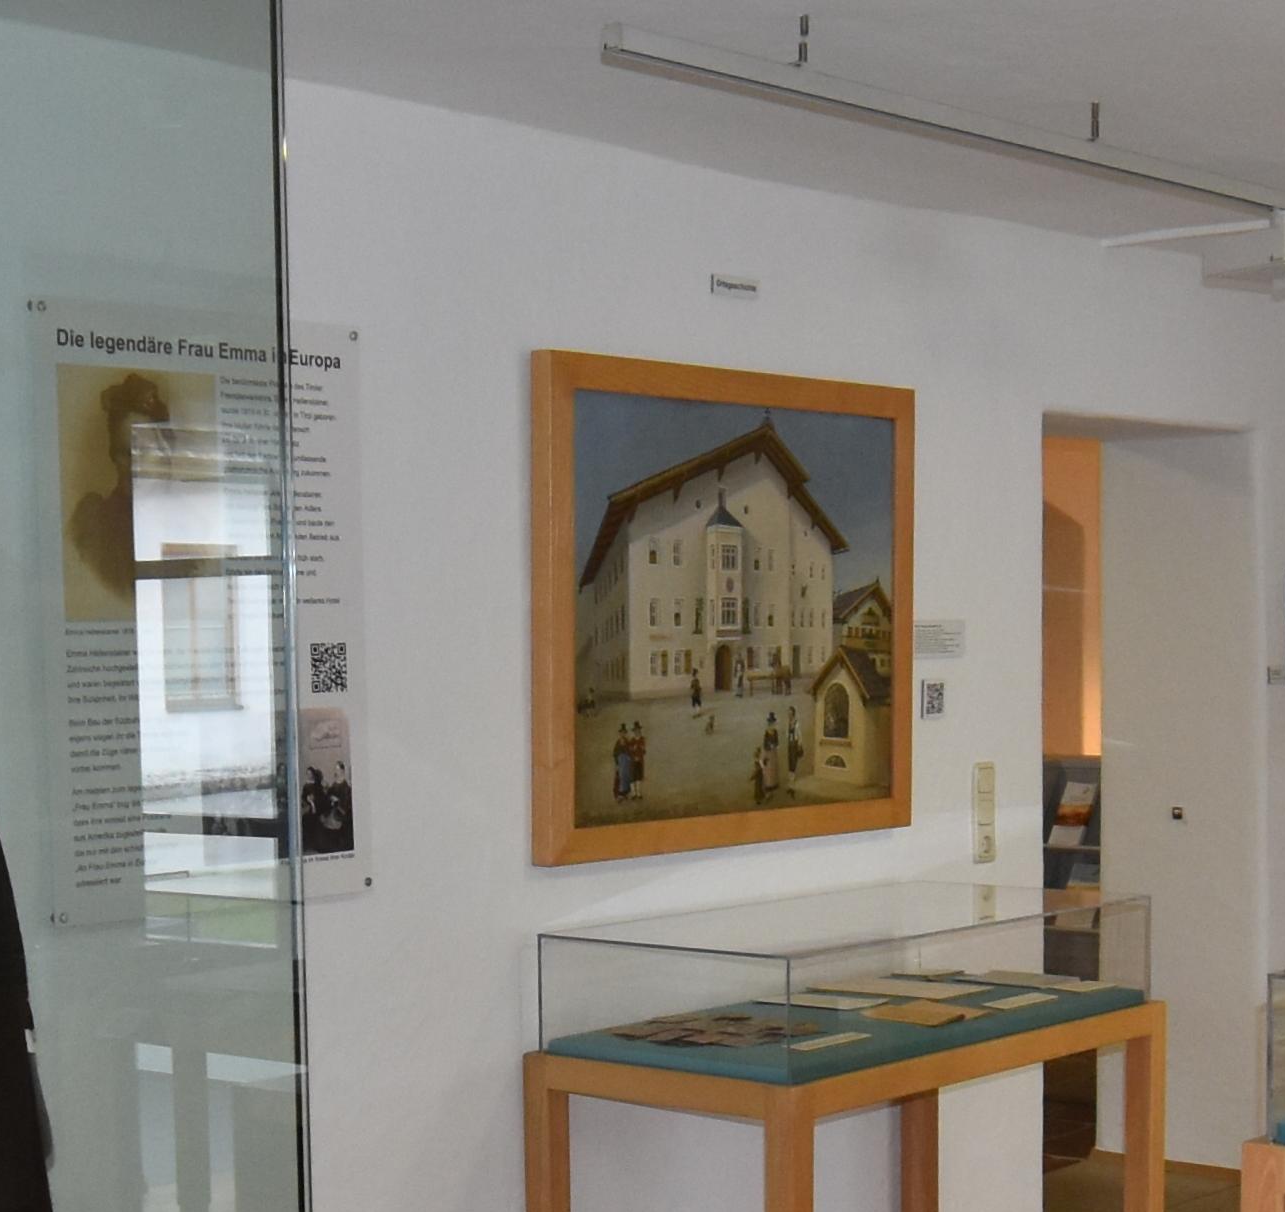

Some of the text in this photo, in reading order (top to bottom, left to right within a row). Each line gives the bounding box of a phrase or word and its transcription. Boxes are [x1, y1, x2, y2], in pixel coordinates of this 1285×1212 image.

[56, 328, 84, 348] Die
[90, 331, 172, 354] legendäre
[178, 339, 214, 358] Frau
[219, 342, 267, 363] Emma
[289, 348, 341, 371] Europa
